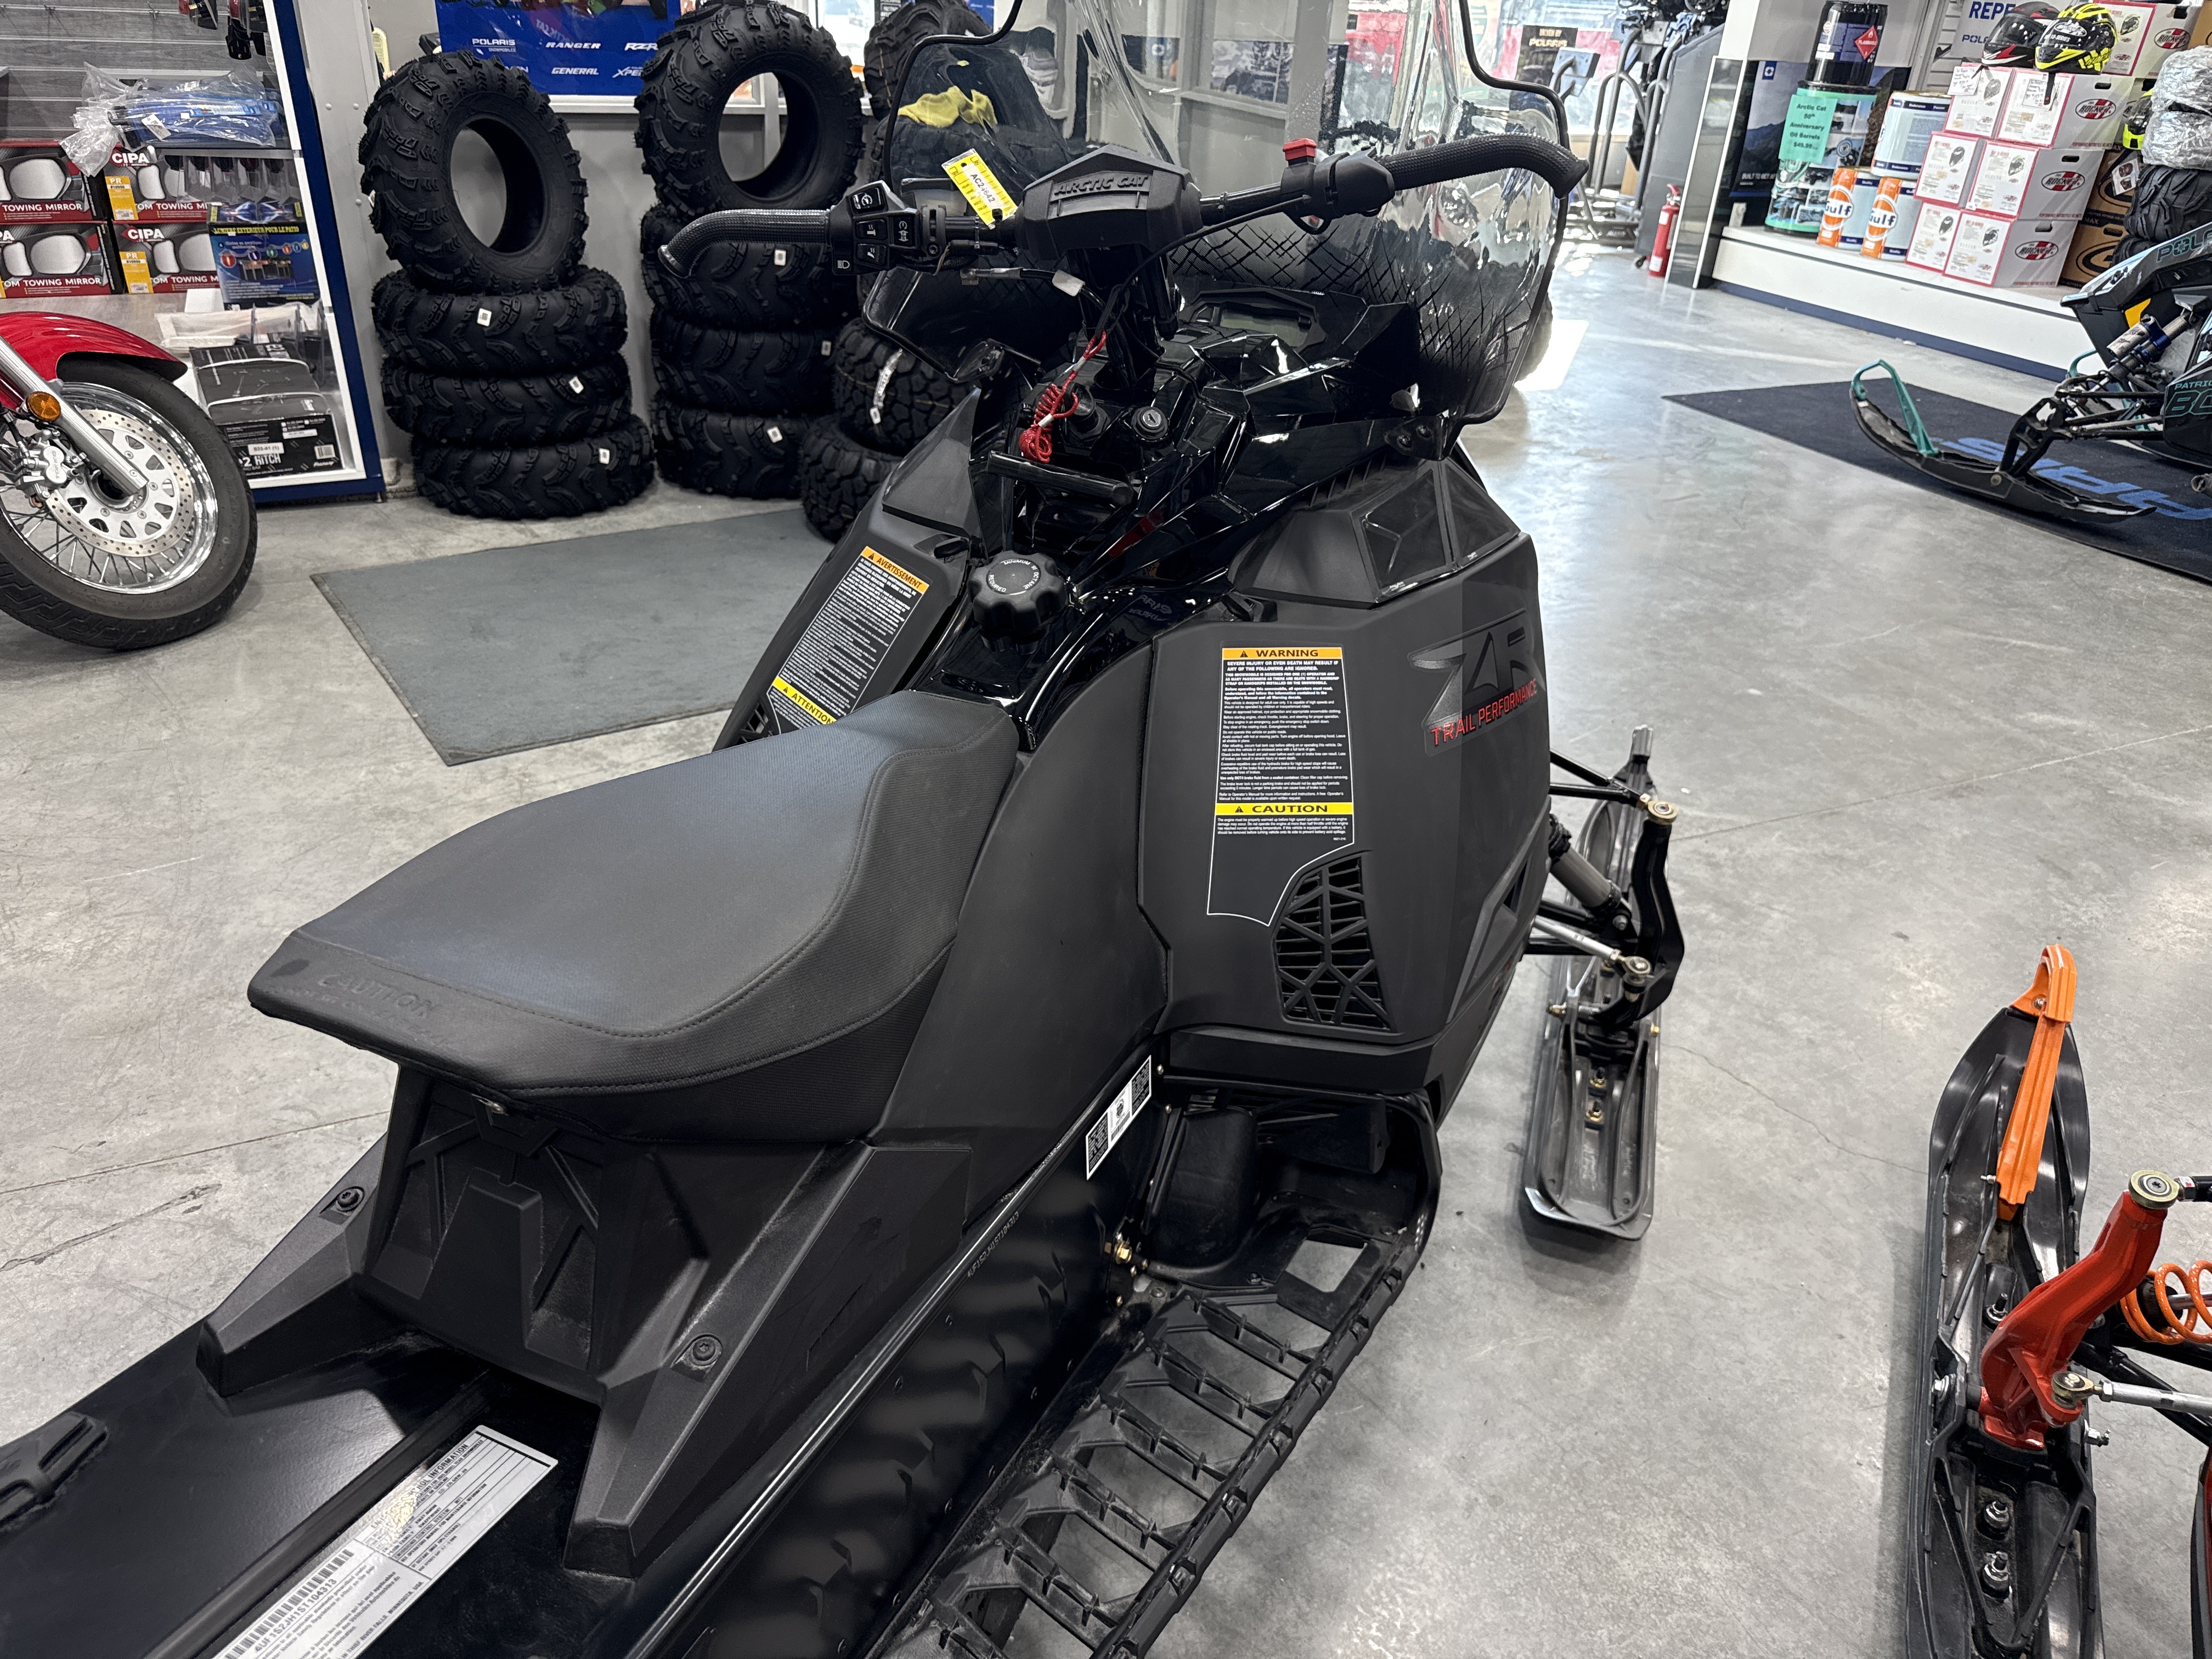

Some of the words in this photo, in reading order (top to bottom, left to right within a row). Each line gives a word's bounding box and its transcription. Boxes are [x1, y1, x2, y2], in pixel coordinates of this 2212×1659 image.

[624, 42, 658, 50] RZR
[551, 67, 599, 75] GENERAL
[1790, 122, 1825, 132] Anniversary
[112, 153, 150, 163] CIPA
[1054, 177, 1114, 196] ARCTIC
[1117, 176, 1148, 188] CAT
[128, 228, 165, 239] CIPA
[255, 454, 281, 466] HITCH
[877, 557, 922, 589] AVERTISSEMENT
[1023, 572, 1039, 589] OCTANE
[989, 574, 1007, 592] REQUIRED
[791, 692, 834, 724] ATTENTION
[1431, 714, 1476, 746] TRAIL
[1478, 678, 1537, 726] PERFORMANCE
[1252, 805, 1328, 813] CAUTION
[427, 1443, 469, 1478] INFORMATION
[254, 1579, 337, 1652] 4UF1S2JH1ST104313
